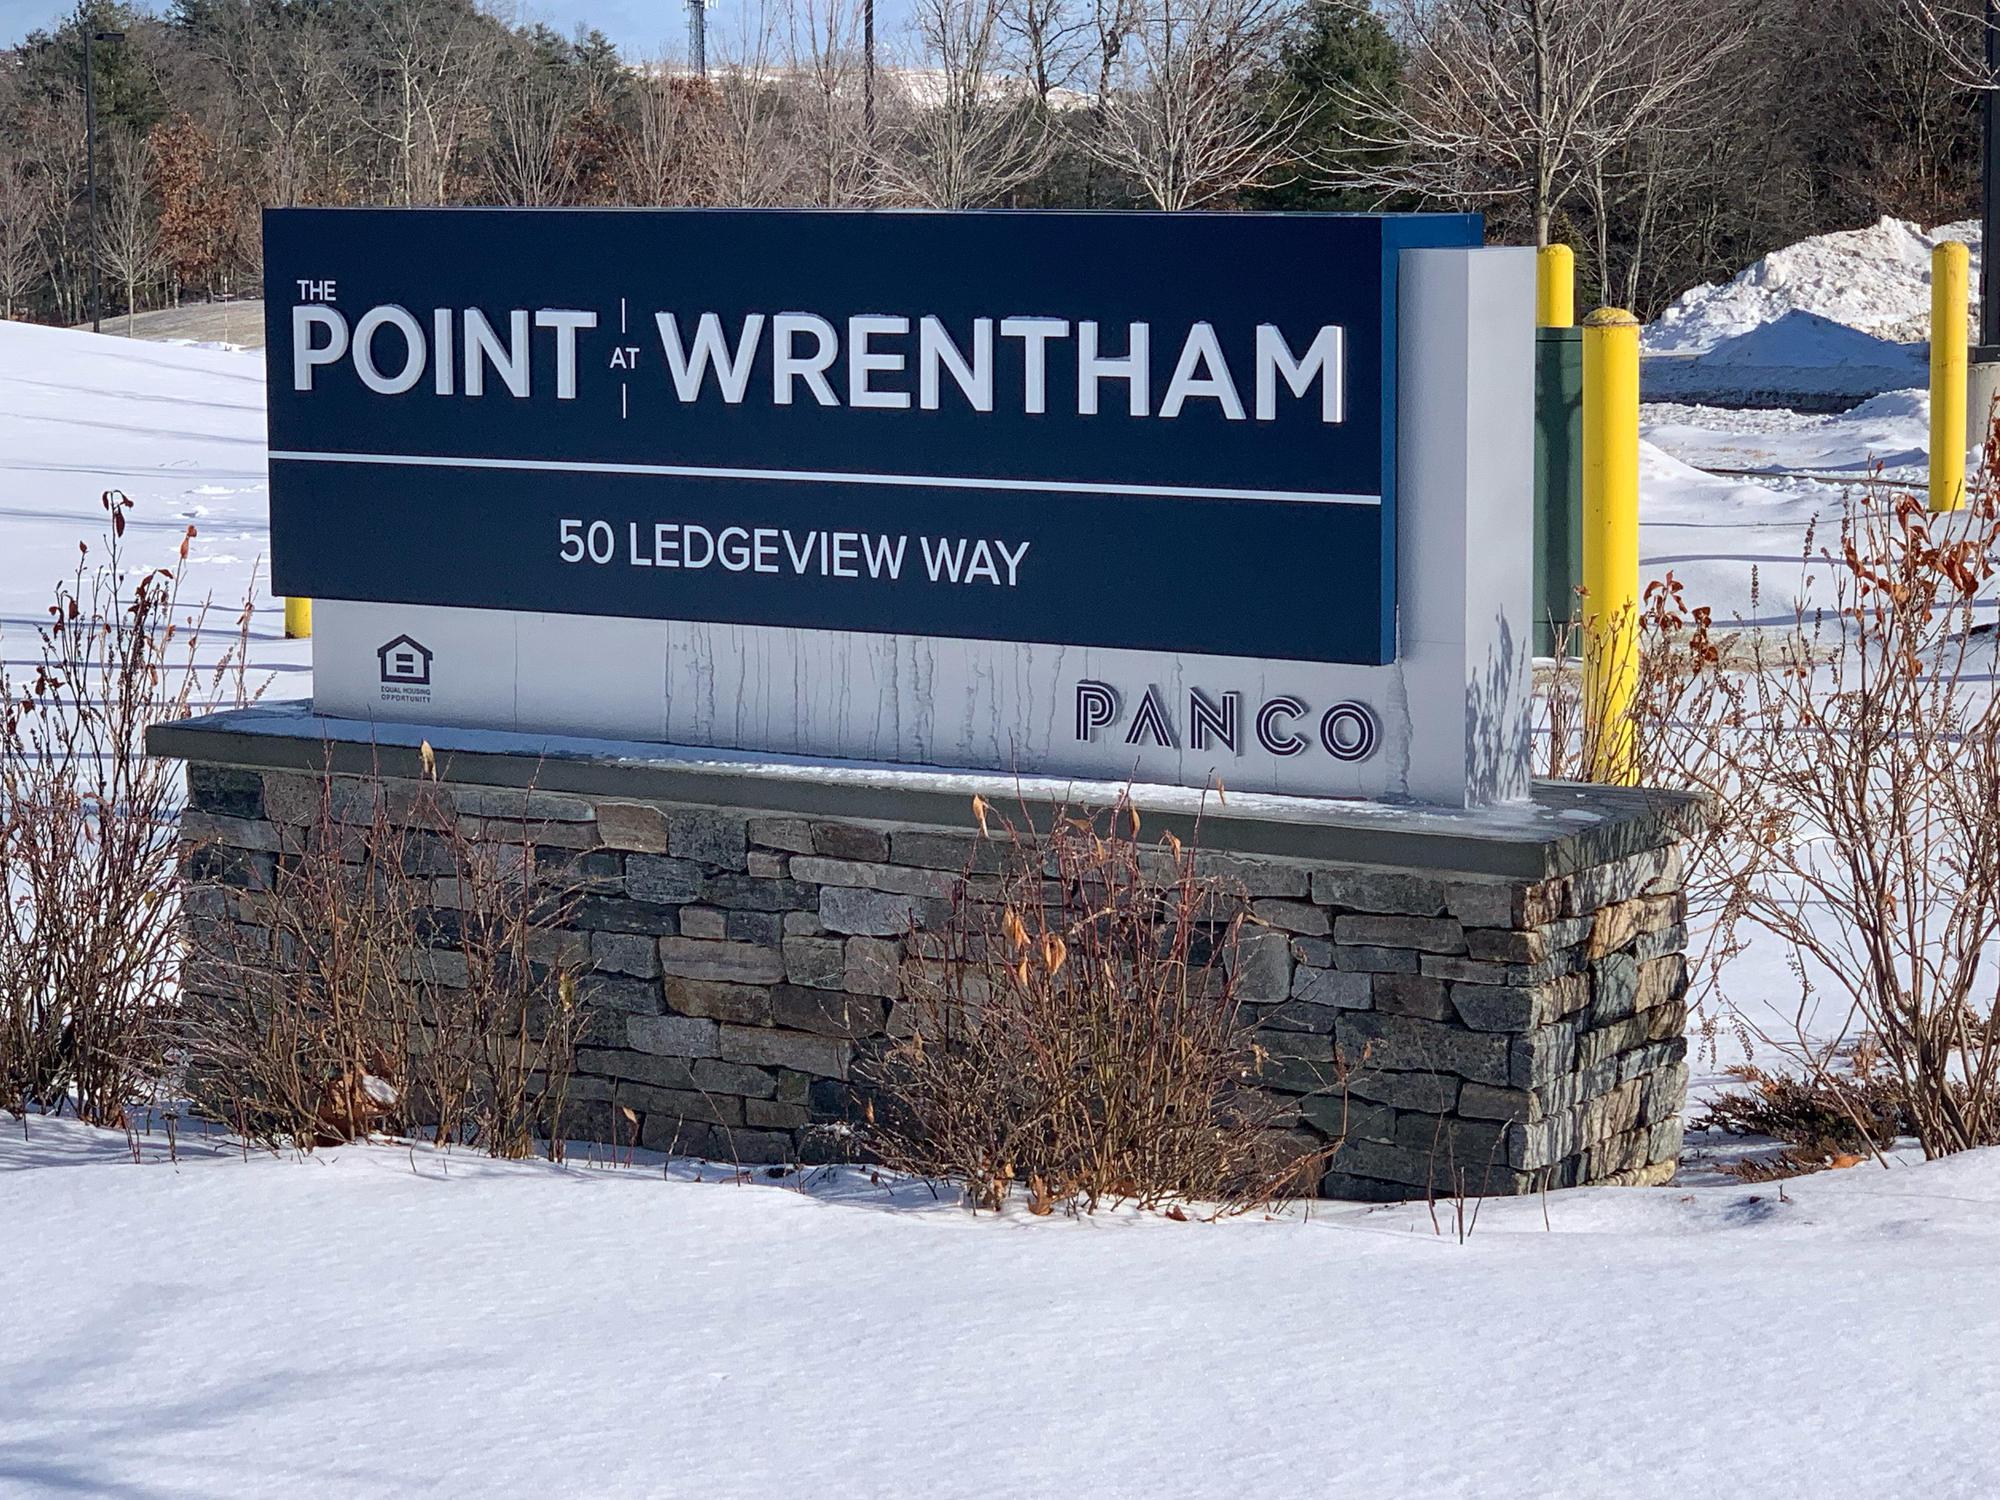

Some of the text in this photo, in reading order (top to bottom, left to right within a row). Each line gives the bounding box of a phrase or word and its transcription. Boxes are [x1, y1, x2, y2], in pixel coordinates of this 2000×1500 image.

[297, 279, 337, 301] THE
[292, 304, 1346, 424] POINT AT WRENTHAM
[559, 518, 1030, 587] 50 LEDGEVIEW WAY
[381, 685, 431, 696] EQUAL HOUSING
[381, 693, 432, 703] OPPORTUNITY
[1075, 681, 1380, 763] PANCO
